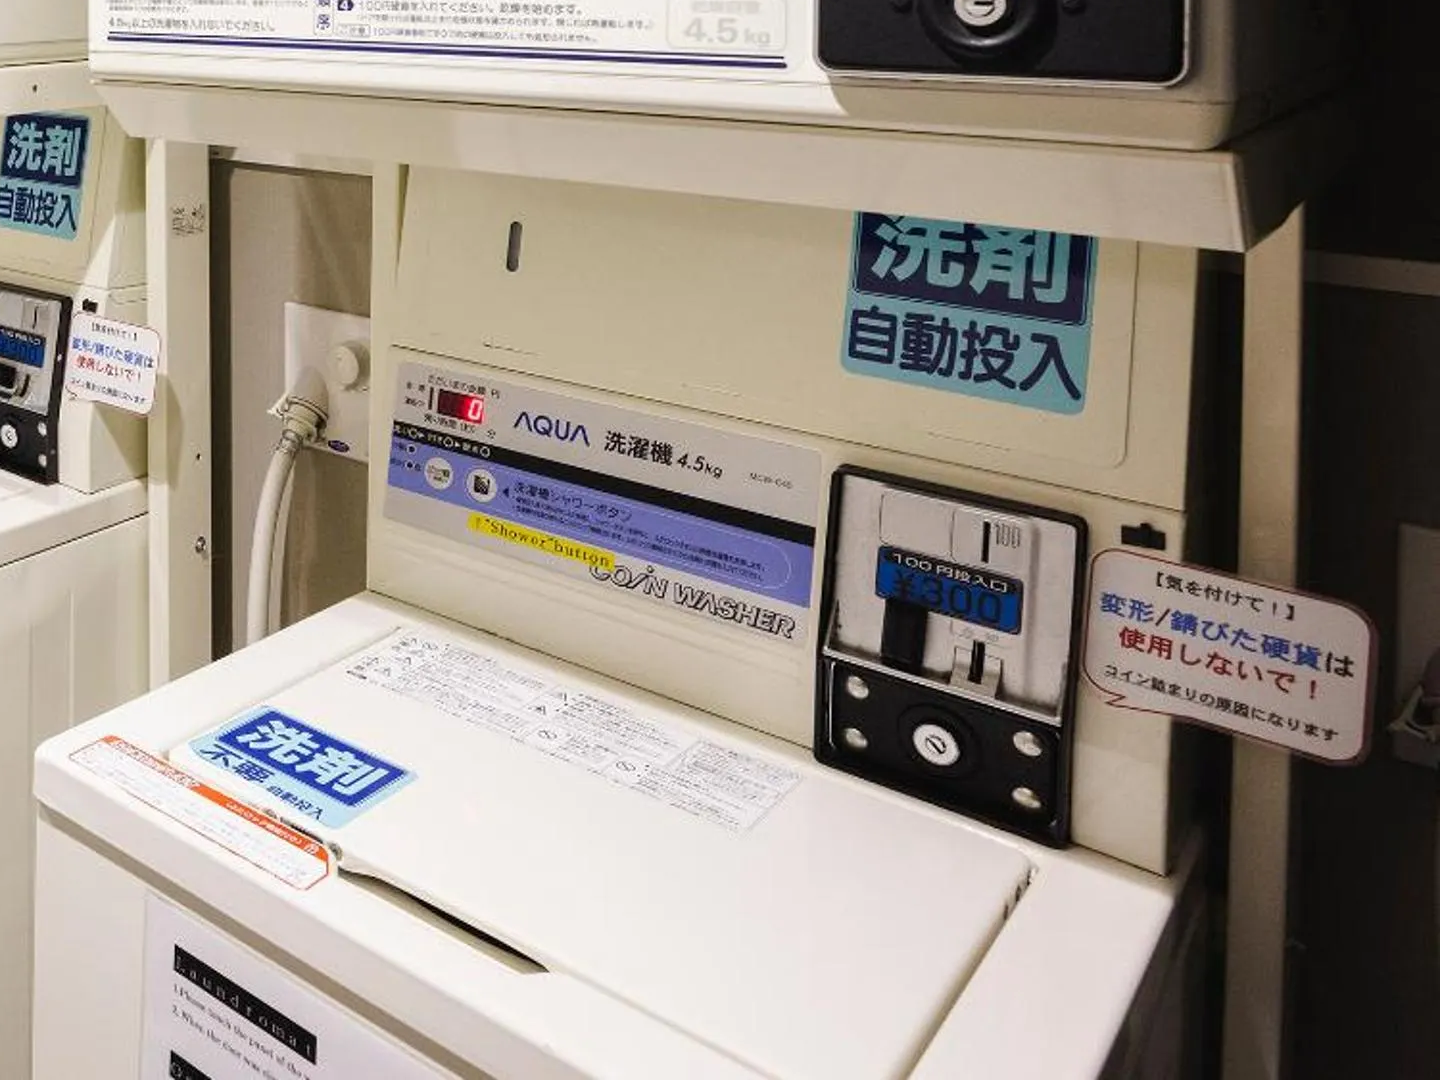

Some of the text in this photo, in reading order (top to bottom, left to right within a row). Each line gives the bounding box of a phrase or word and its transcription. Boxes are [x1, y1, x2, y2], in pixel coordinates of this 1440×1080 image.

[7, 121, 82, 177] 洗剤
[870, 213, 1072, 304] 洗剤
[848, 305, 1082, 401] 自動投入
[468, 399, 483, 420] 0
[513, 411, 591, 447] AQUA
[604, 430, 674, 467] 洗濯機
[677, 453, 723, 480] 4.5kg
[893, 552, 1008, 593] 100円投入口
[994, 522, 1021, 549] 100
[589, 563, 796, 639] COIN WASHER
[1100, 591, 1355, 678] 変形/錆びた硬貨は
[1118, 626, 1318, 701] 使用しないで！
[1104, 664, 1340, 741] コイン詰まりの原因になります
[201, 743, 275, 784] 不要
[236, 719, 389, 797] 洗剤
